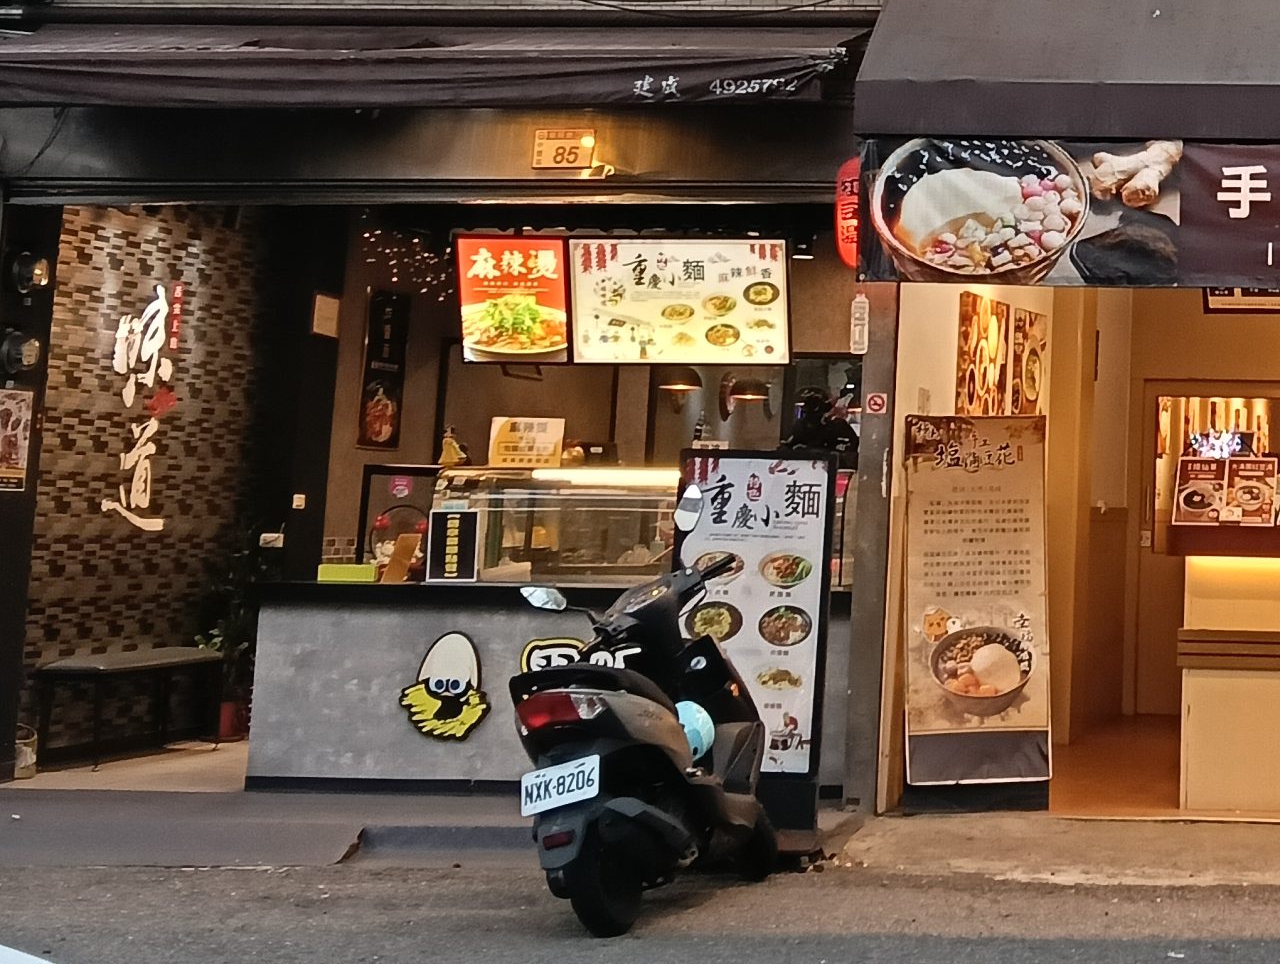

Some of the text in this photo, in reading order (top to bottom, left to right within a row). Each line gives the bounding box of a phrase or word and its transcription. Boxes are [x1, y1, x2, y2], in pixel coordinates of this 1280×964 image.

[553, 146, 579, 164] 85
[467, 247, 559, 280] 麻辣燙
[702, 474, 821, 531] 重慶小麵
